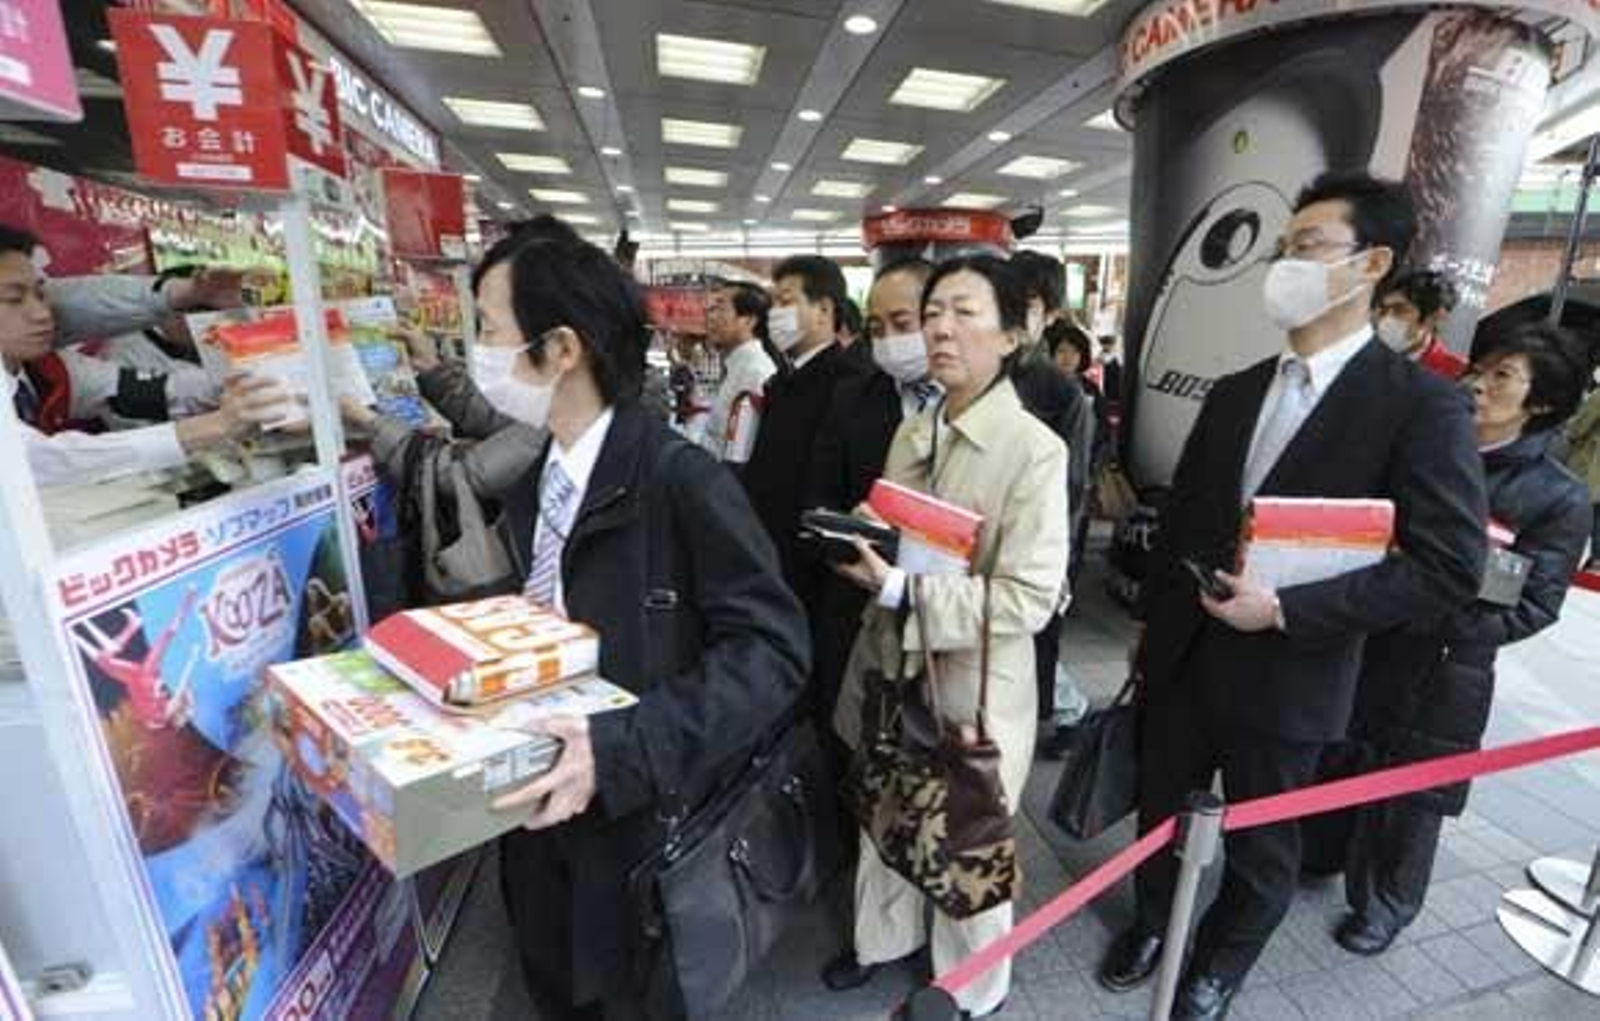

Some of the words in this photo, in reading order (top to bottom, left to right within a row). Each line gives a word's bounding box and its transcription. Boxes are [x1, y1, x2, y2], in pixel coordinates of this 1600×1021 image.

[1132, 0, 1279, 62] CAMER
[158, 125, 256, 155] お会計
[58, 529, 202, 608] ビックカメラ
